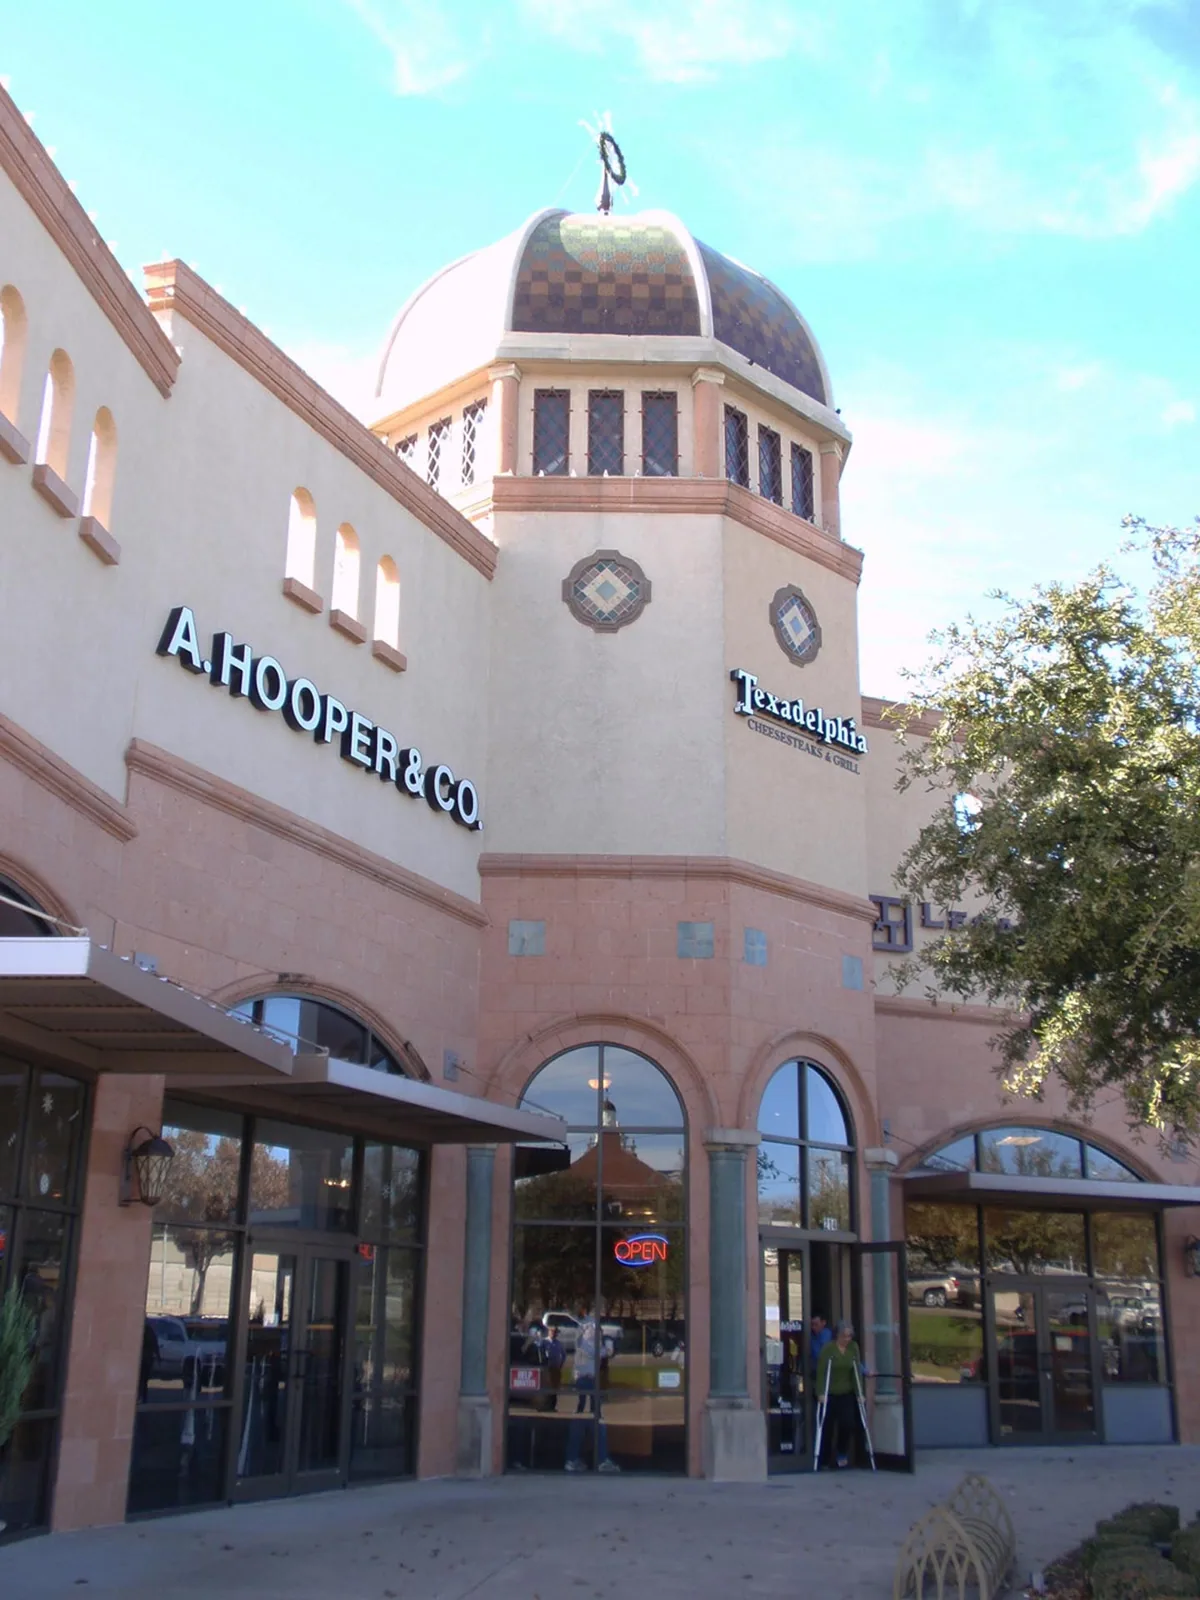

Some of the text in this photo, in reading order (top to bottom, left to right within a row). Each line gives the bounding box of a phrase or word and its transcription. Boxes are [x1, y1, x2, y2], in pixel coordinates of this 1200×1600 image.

[730, 668, 868, 755] Texadelphia
[747, 718, 861, 775] CHEESESTEAKS & GRILL
[614, 1241, 667, 1260] OPEN
